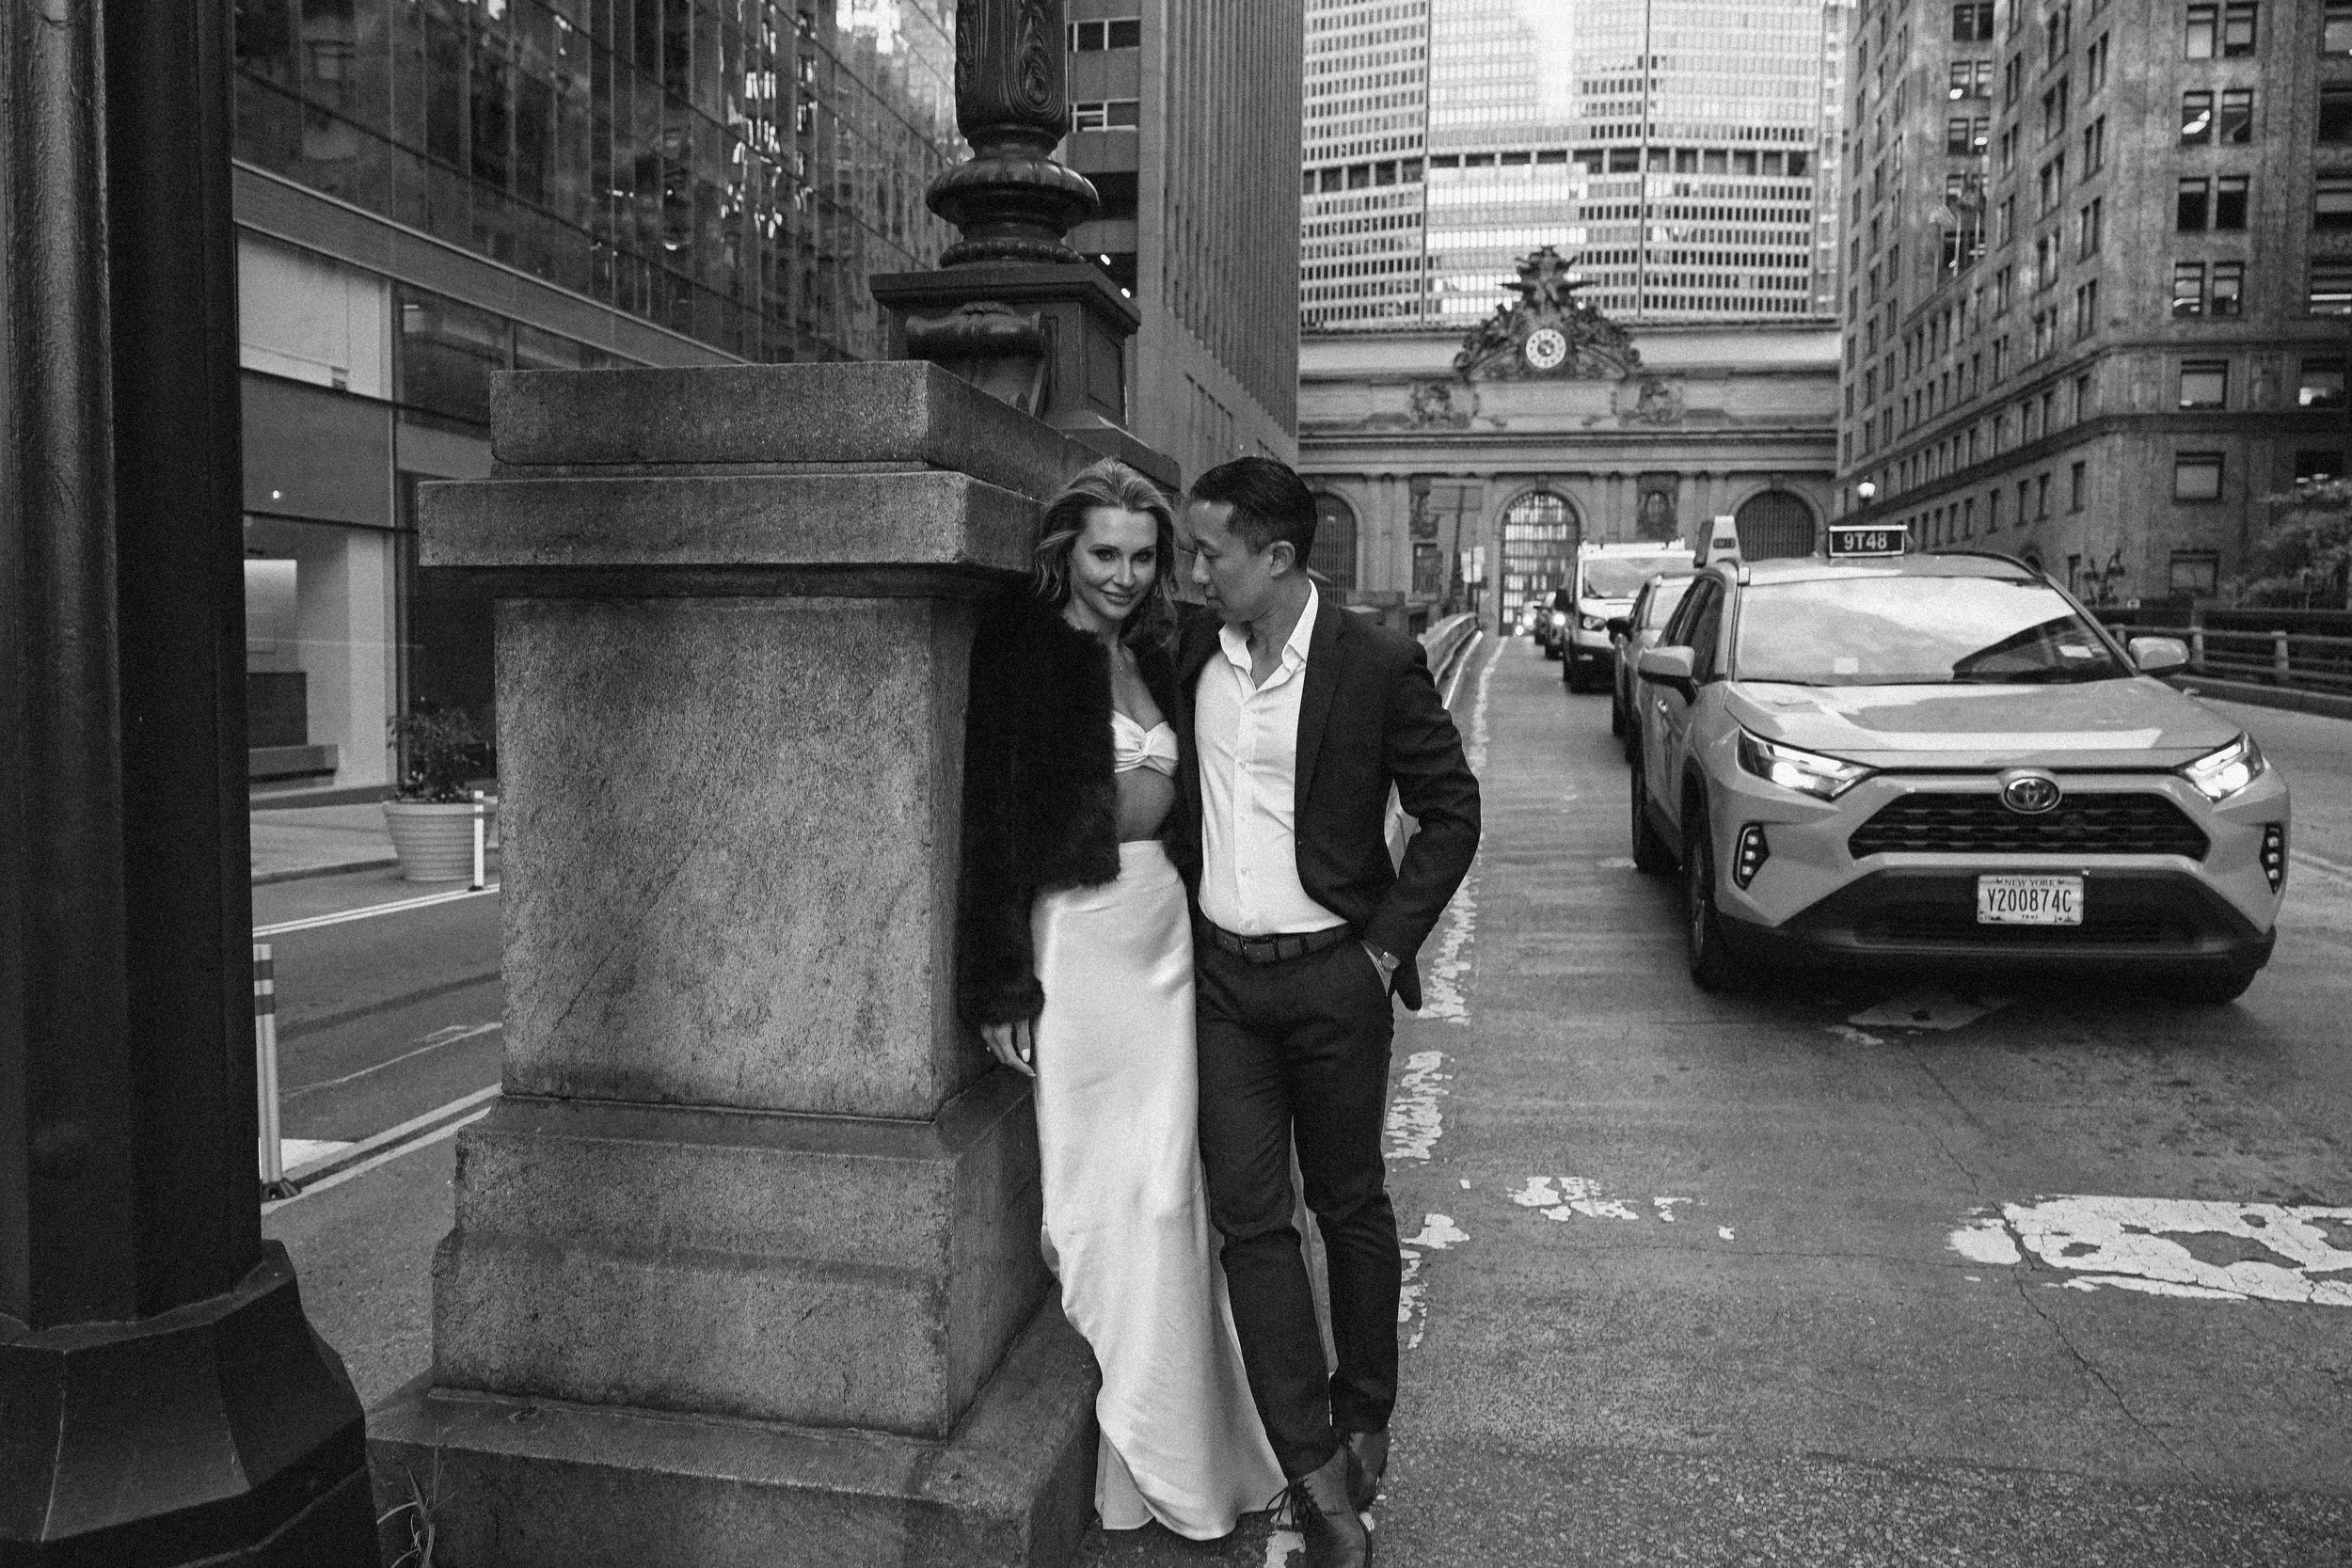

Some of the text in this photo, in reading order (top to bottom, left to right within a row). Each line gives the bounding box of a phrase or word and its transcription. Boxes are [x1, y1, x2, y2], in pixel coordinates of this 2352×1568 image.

[1844, 532, 1887, 550] 9T48
[2030, 879, 2056, 887] YORK
[1987, 888, 2072, 912] Y200874C
